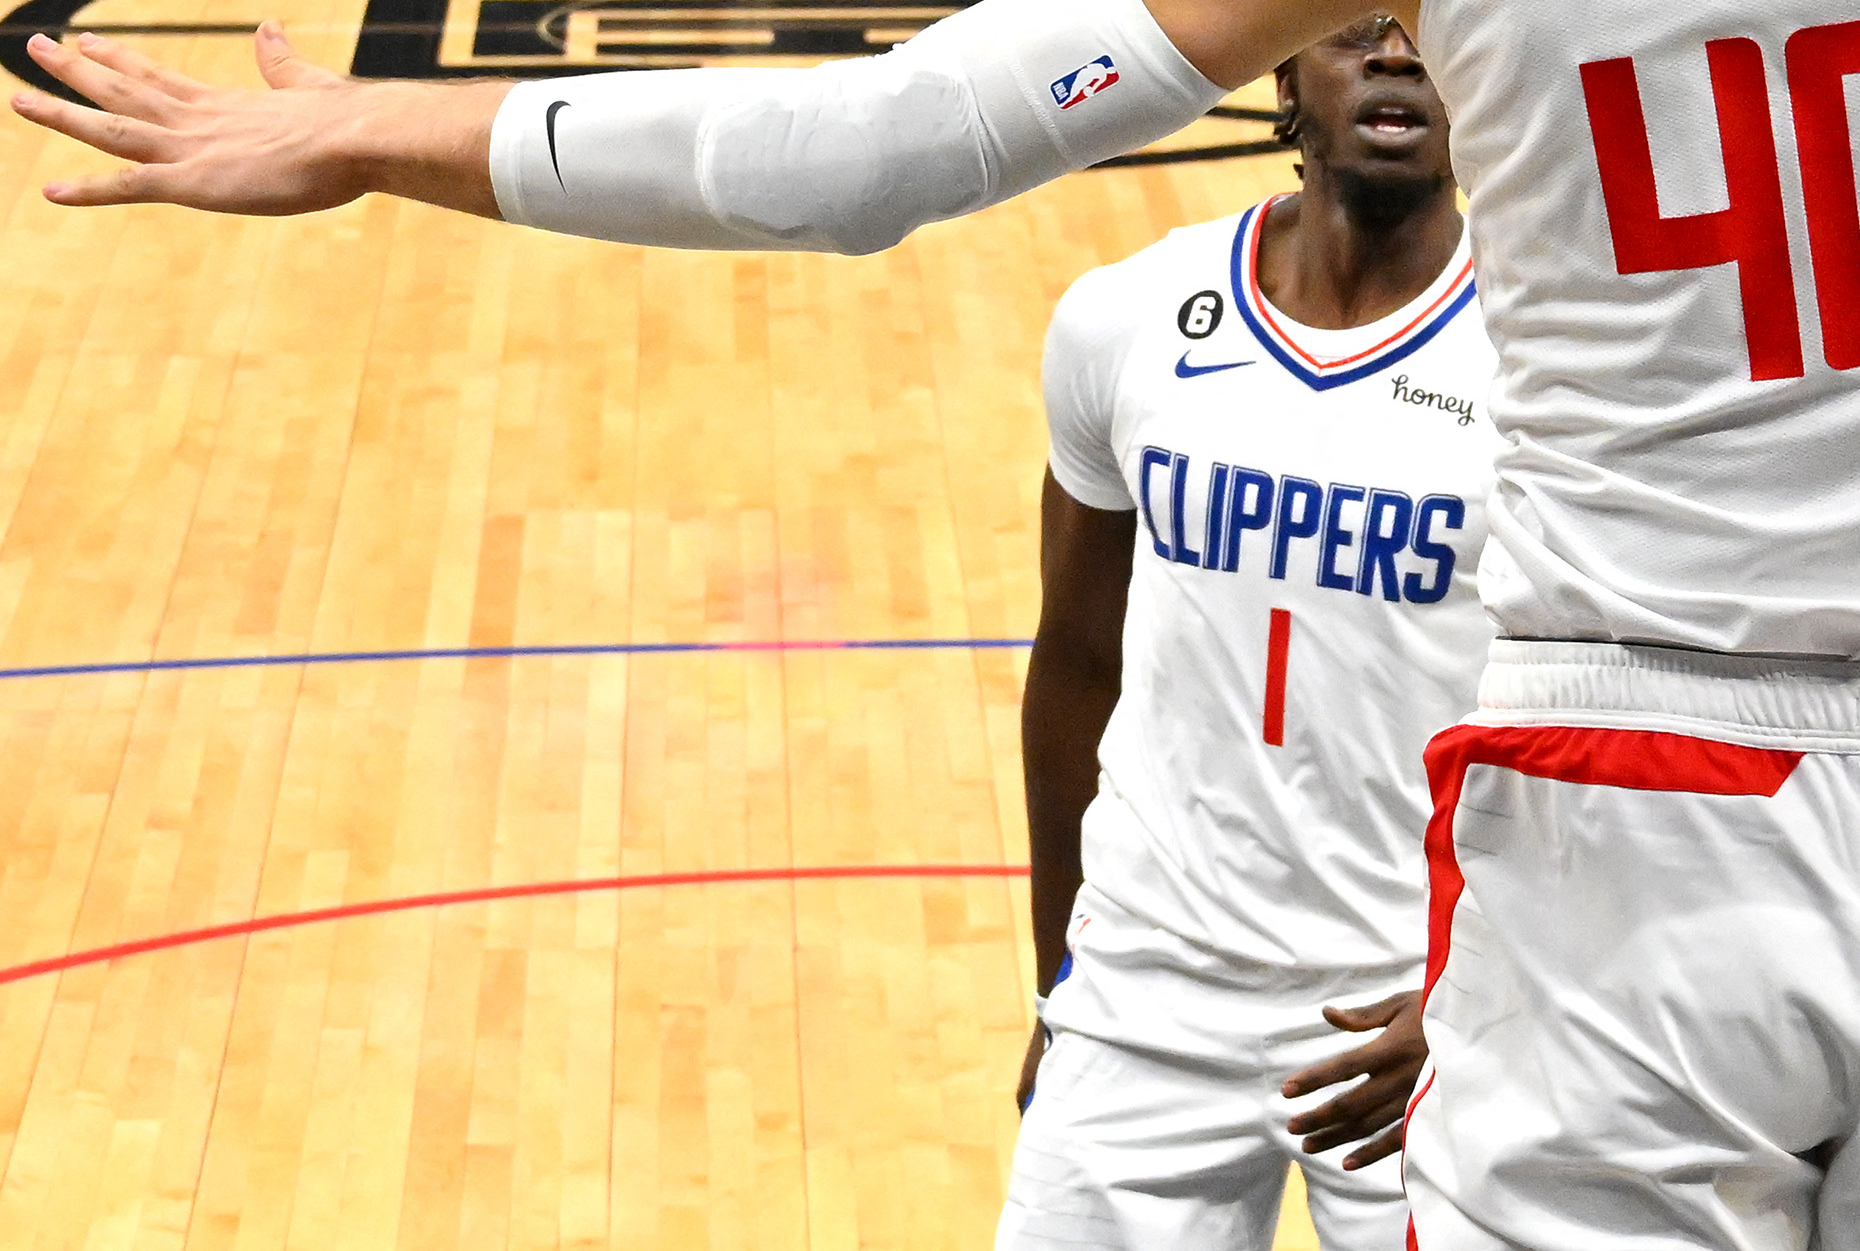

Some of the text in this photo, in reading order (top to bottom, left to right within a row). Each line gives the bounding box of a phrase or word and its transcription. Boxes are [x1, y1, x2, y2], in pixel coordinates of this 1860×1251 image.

[1185, 296, 1217, 335] 6
[1391, 374, 1475, 427] honey
[1139, 445, 1465, 604] CLIPPERS
[1262, 607, 1291, 747] 1
